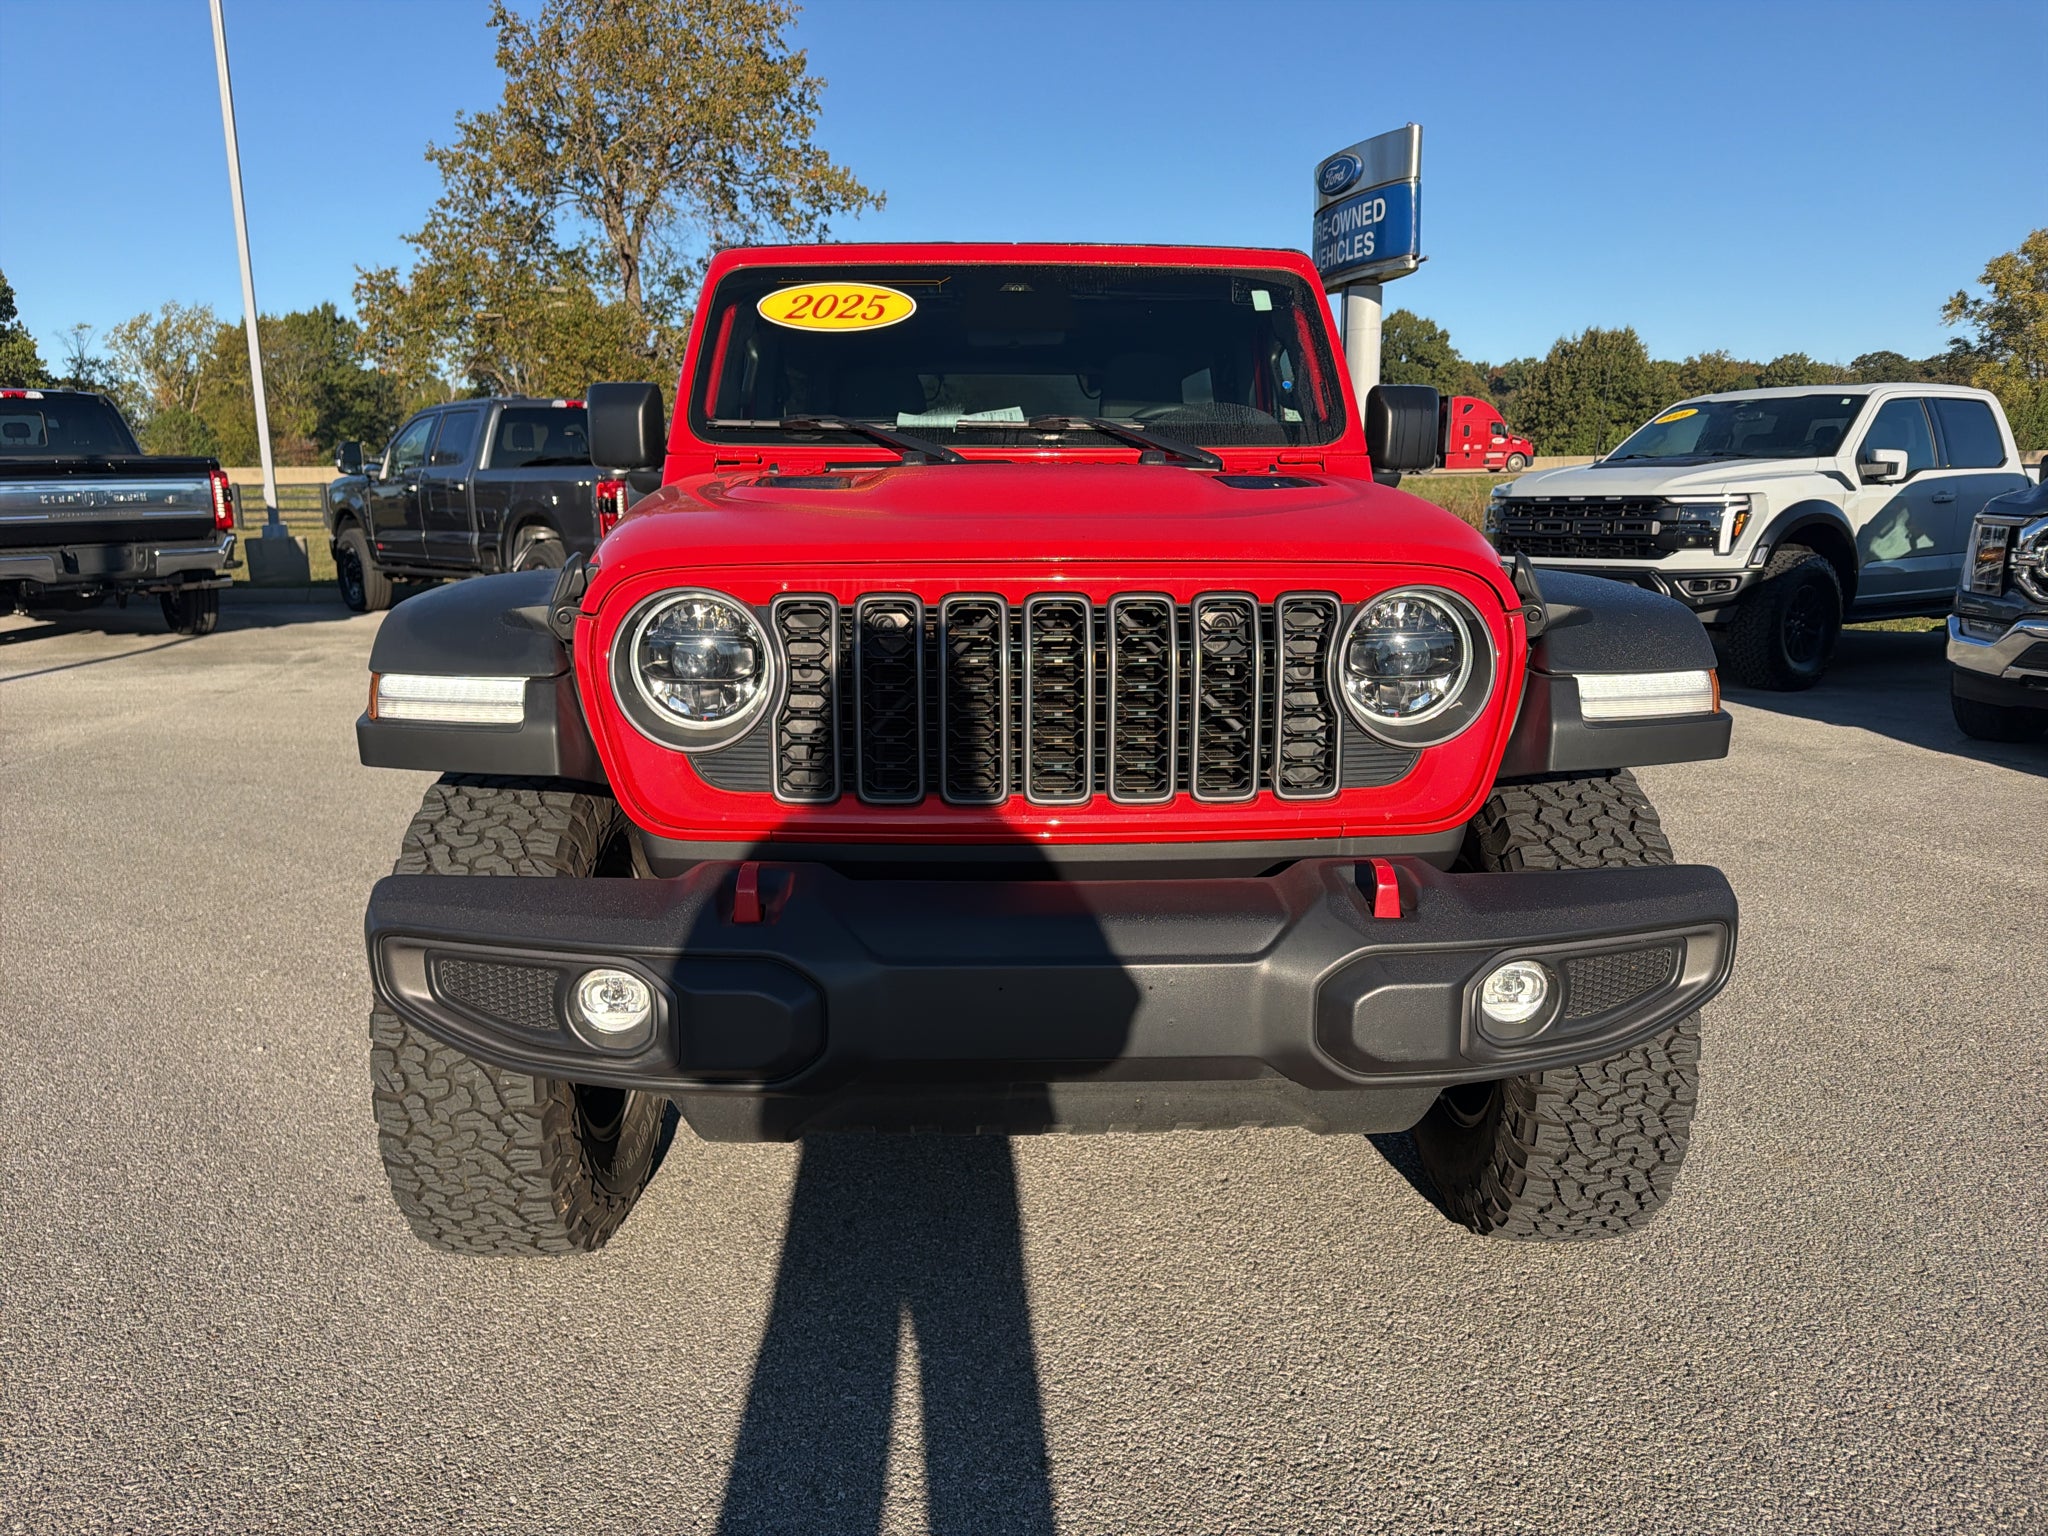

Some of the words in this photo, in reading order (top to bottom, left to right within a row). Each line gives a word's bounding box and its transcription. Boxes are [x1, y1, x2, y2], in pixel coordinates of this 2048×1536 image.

[1324, 164, 1346, 189] Ford
[1314, 197, 1386, 244] RE-OWNED
[783, 294, 891, 321] 2025
